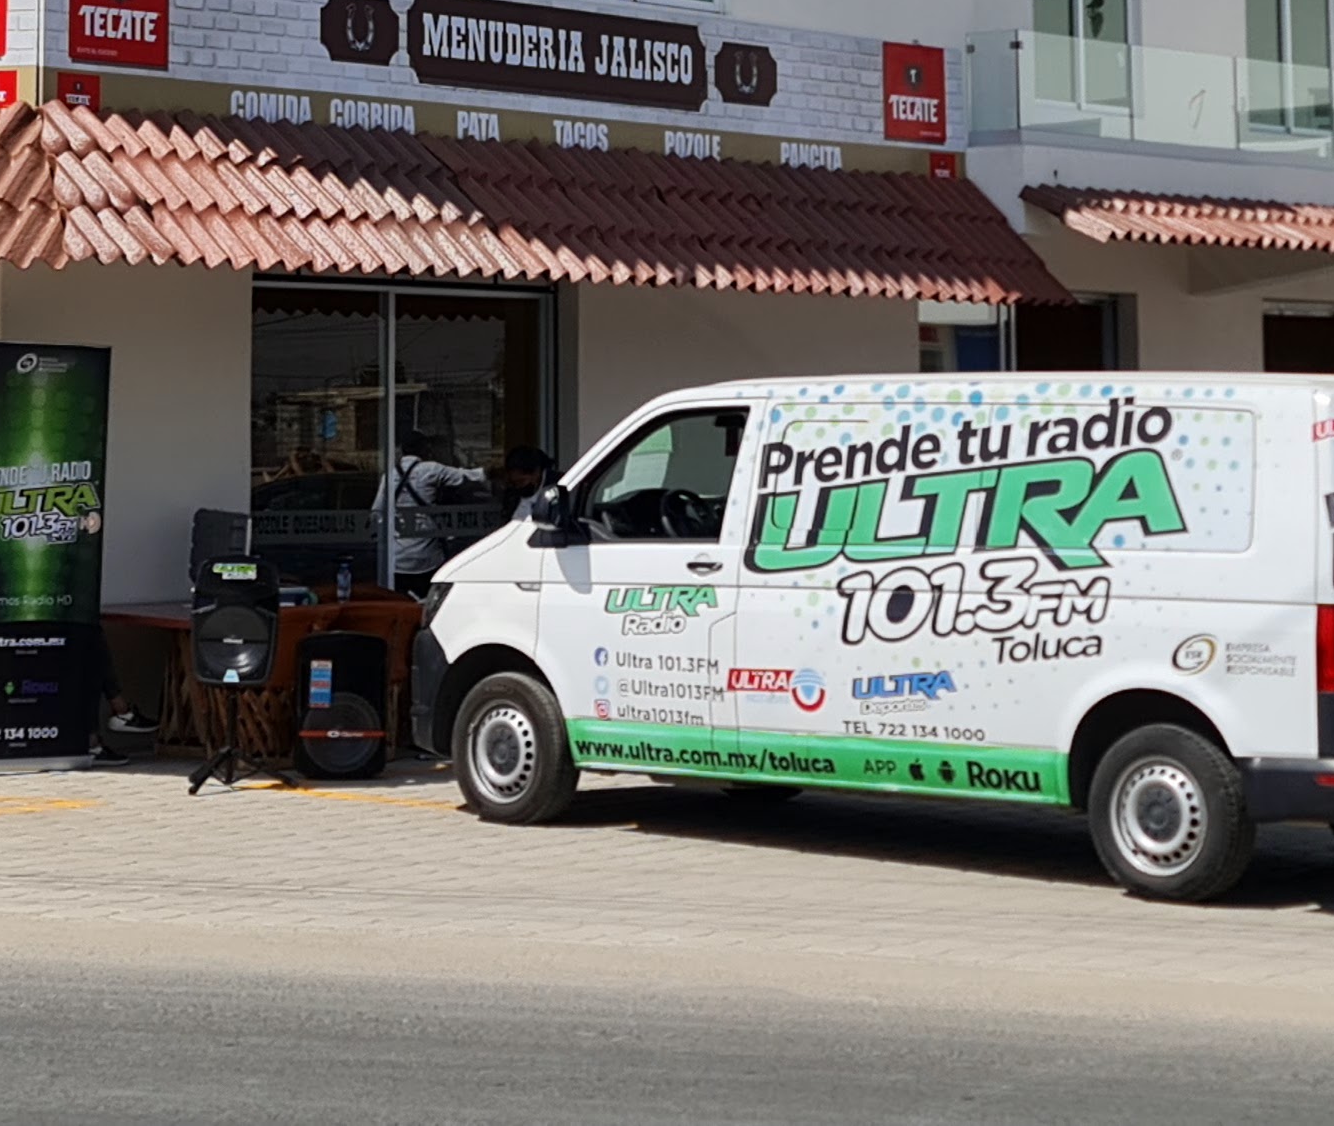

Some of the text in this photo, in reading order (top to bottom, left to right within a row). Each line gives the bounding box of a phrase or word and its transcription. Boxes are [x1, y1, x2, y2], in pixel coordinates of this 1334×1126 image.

[77, 4, 161, 43] TECATE
[422, 12, 694, 86] MENUDERIA JALISCO
[230, 90, 312, 124] COMIDA
[888, 94, 940, 124] TECATE
[457, 111, 500, 143] PATA
[553, 120, 609, 152] TACOS
[665, 130, 721, 161] POZOLE
[763, 397, 1173, 487] Prende tu radio
[744, 448, 1189, 572] ULTRA
[23, 594, 54, 605] Radio
[57, 594, 72, 605] HD
[604, 584, 719, 617] ULTRA
[837, 556, 1111, 645] 101.3FM
[621, 614, 687, 636] Radio
[616, 652, 719, 675] Ultra 101.3FM
[992, 634, 1102, 664] Toluca
[618, 680, 725, 702] @Ultra1013FM
[730, 671, 791, 690] ULTRA
[852, 671, 957, 700] ULTRA
[617, 706, 704, 726] ultra1013fm
[4, 729, 25, 740] 134
[27, 727, 58, 740] 1000
[843, 721, 986, 742] TEL 722 134 1000
[575, 740, 836, 773] www.ultra.com.mx/toluca
[863, 760, 898, 775] APP
